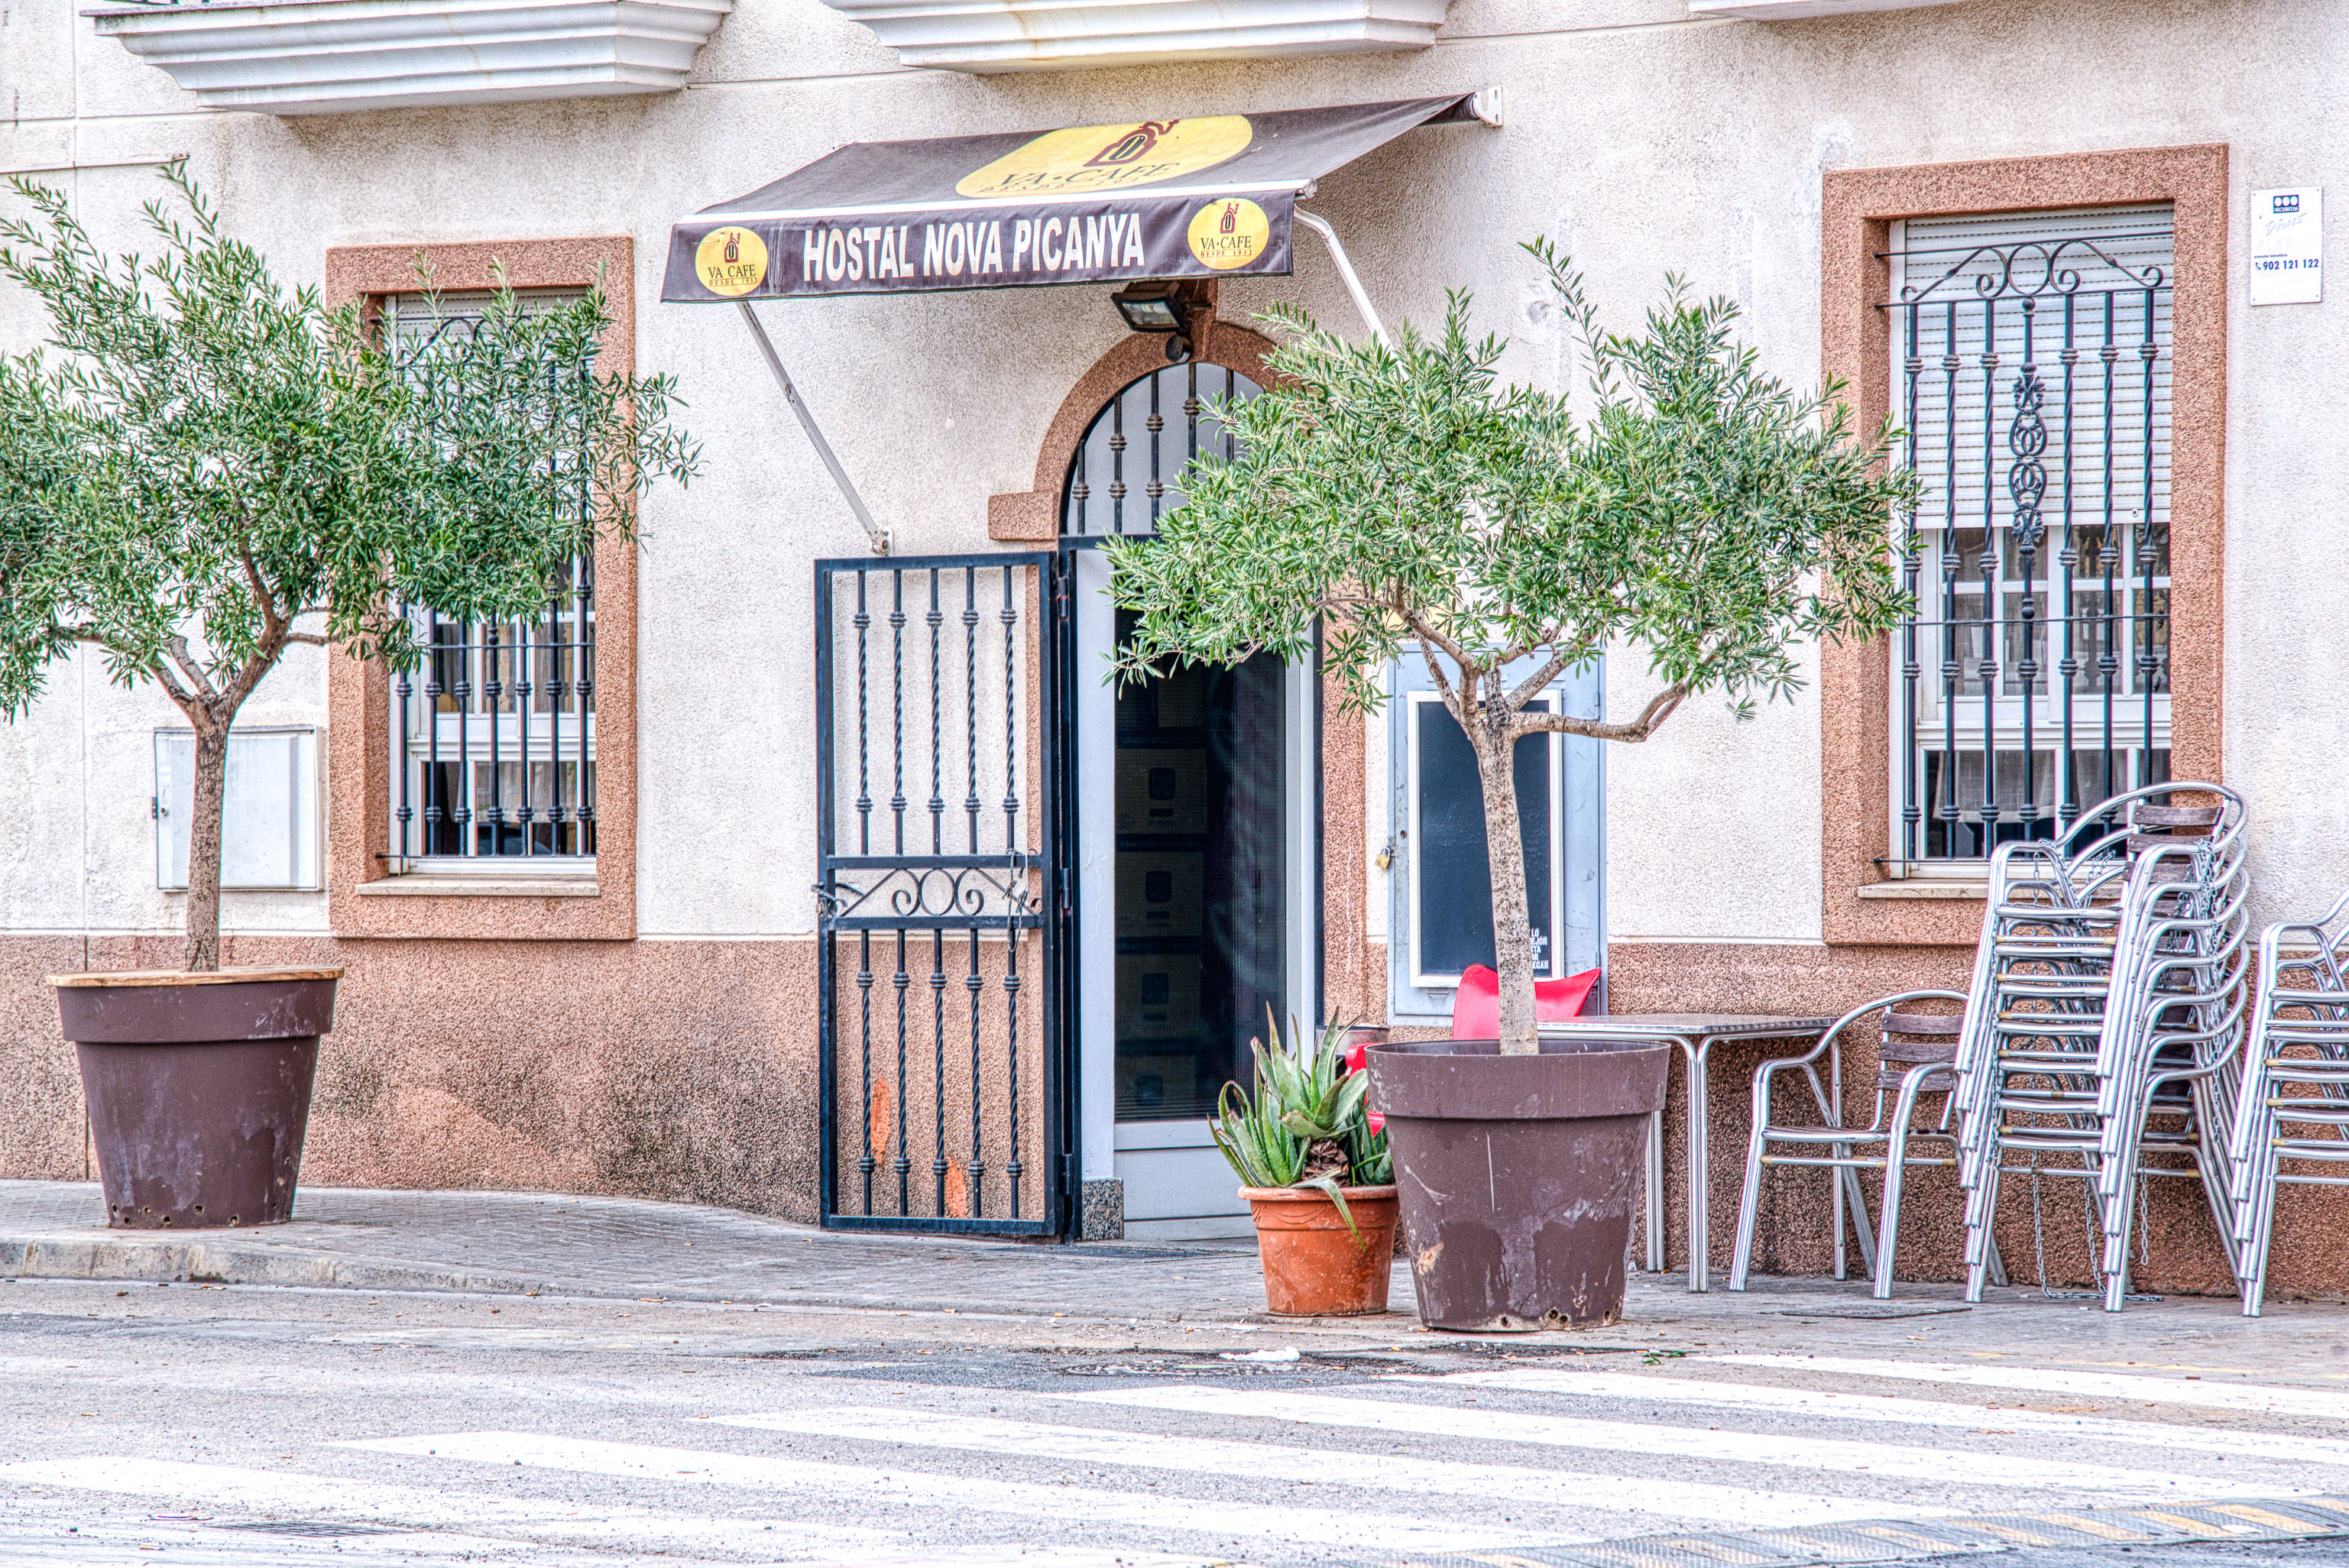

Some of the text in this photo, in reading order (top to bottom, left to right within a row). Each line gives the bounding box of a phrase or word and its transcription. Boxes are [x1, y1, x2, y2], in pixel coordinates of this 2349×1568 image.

[804, 212, 1145, 282] HOSTAL NOVA PICANYA
[708, 264, 756, 278] VA CAFE
[2263, 258, 2318, 271] 902 121 122
[1531, 944, 1541, 954] STA
[1533, 960, 1549, 970] EGAR
